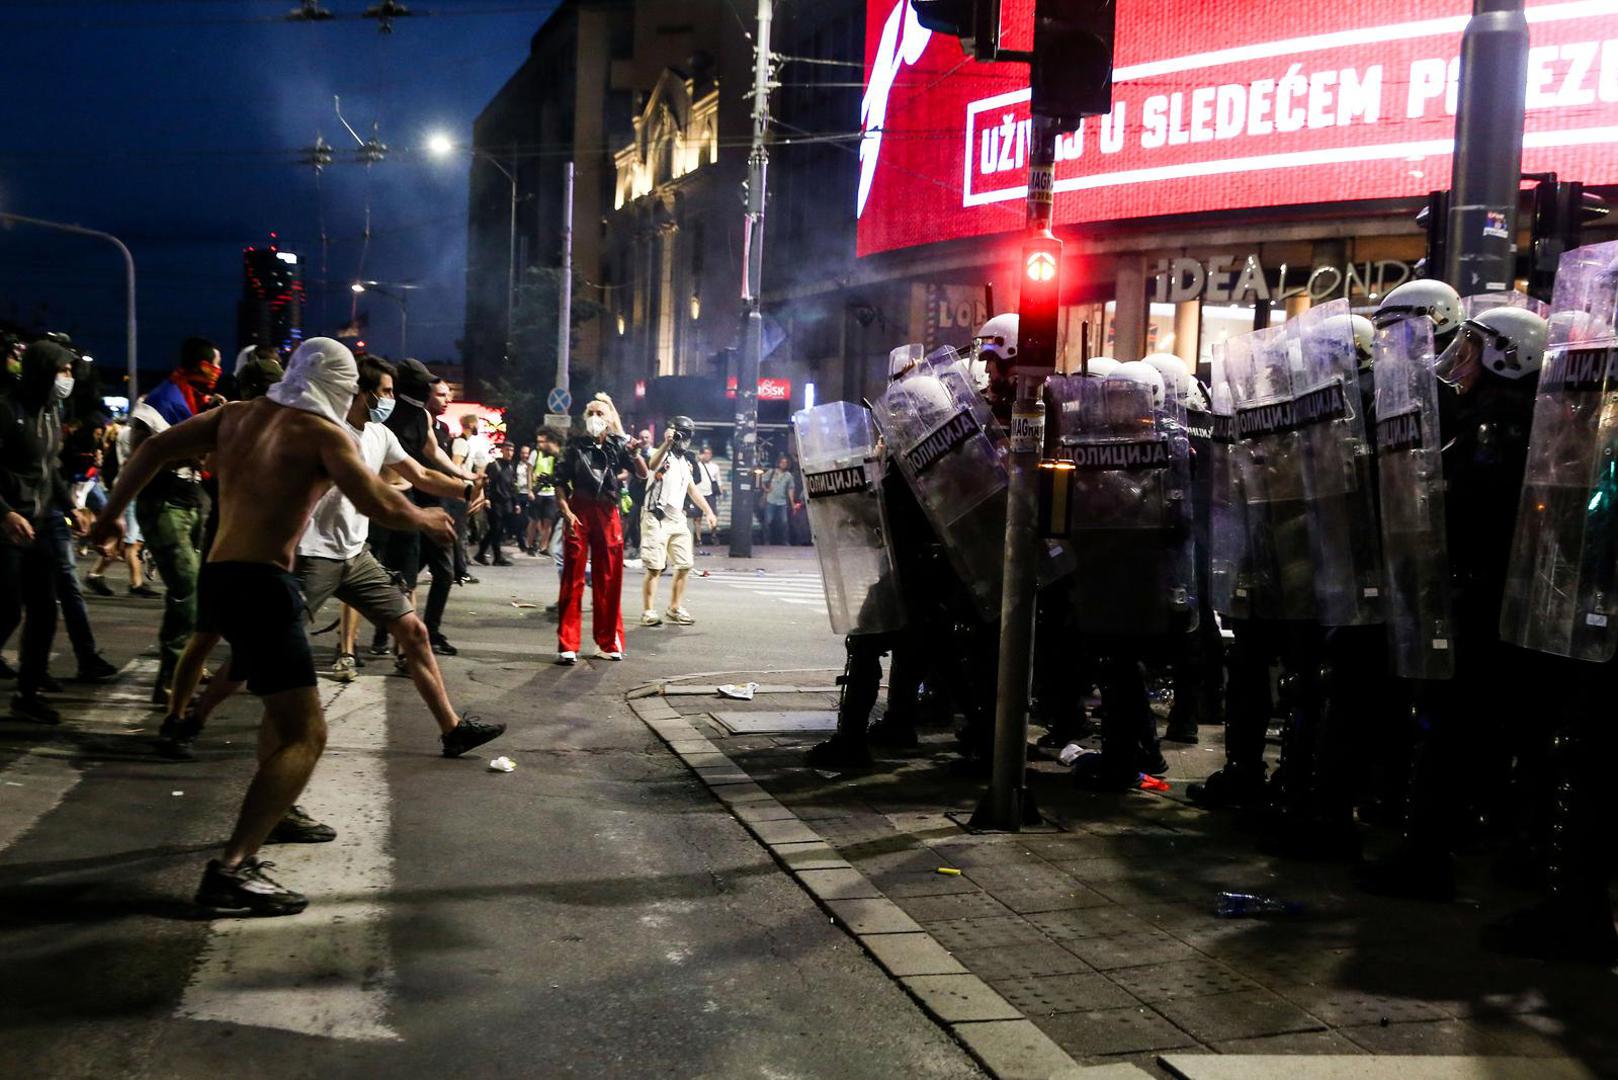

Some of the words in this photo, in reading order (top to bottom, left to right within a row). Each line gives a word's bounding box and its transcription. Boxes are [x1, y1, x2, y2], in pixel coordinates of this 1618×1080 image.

[981, 113, 1084, 174] UŽIJ
[1100, 101, 1126, 154] U
[1141, 63, 1383, 148] SLEDEĆEM
